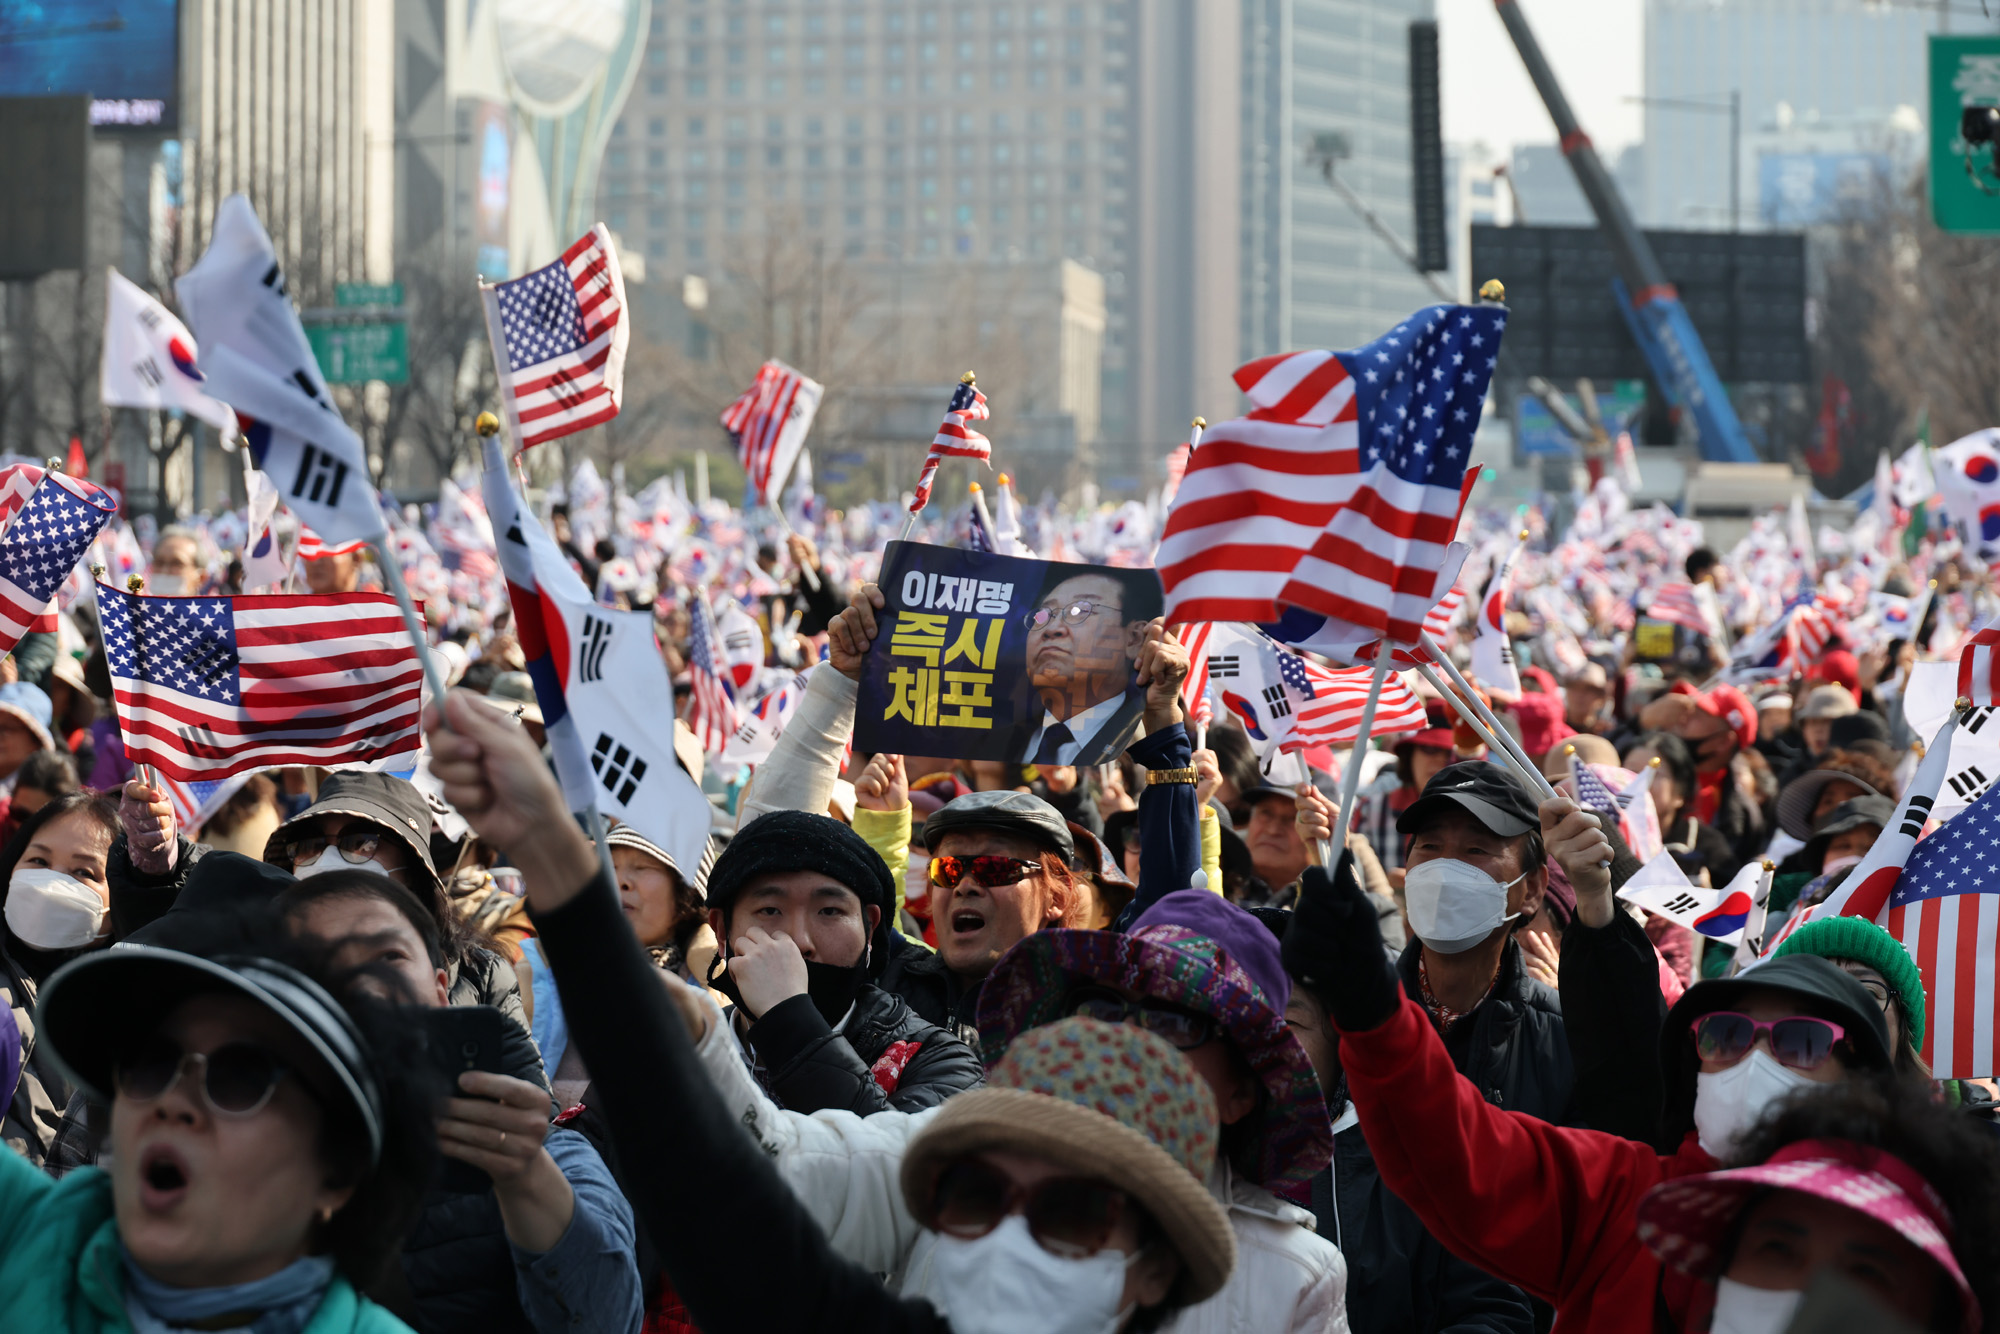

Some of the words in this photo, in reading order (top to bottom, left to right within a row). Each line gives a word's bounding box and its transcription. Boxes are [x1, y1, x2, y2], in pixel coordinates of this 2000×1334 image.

[901, 570, 1014, 615] 이재명
[890, 610, 1006, 670] 즉시
[883, 666, 994, 729] 체포
